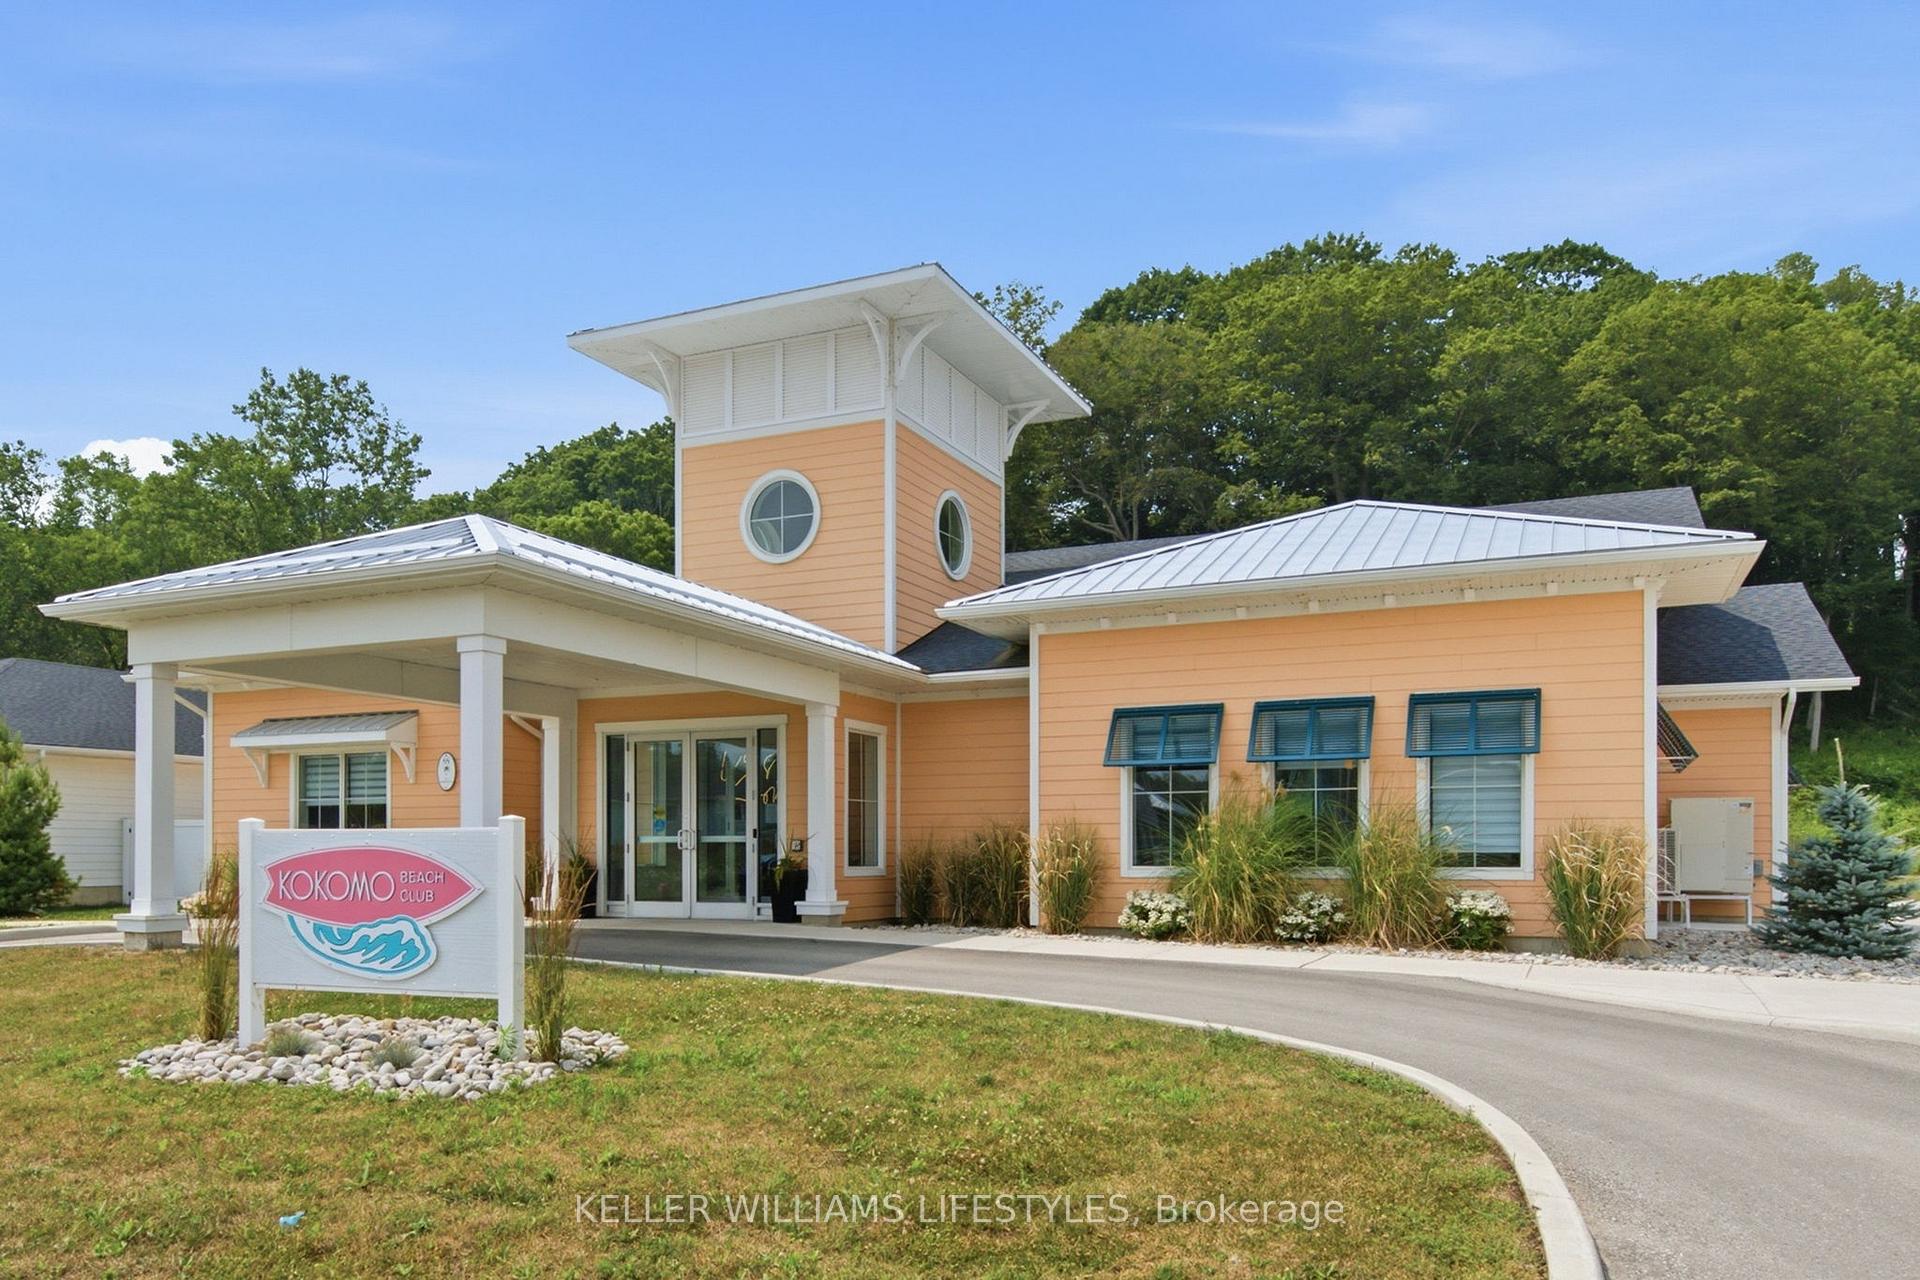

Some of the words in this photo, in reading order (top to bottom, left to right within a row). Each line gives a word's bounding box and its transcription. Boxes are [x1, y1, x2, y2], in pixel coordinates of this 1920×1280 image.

[400, 870, 446, 885] BEACH
[278, 870, 396, 902] KOKOMO
[400, 889, 435, 903] CLUB
